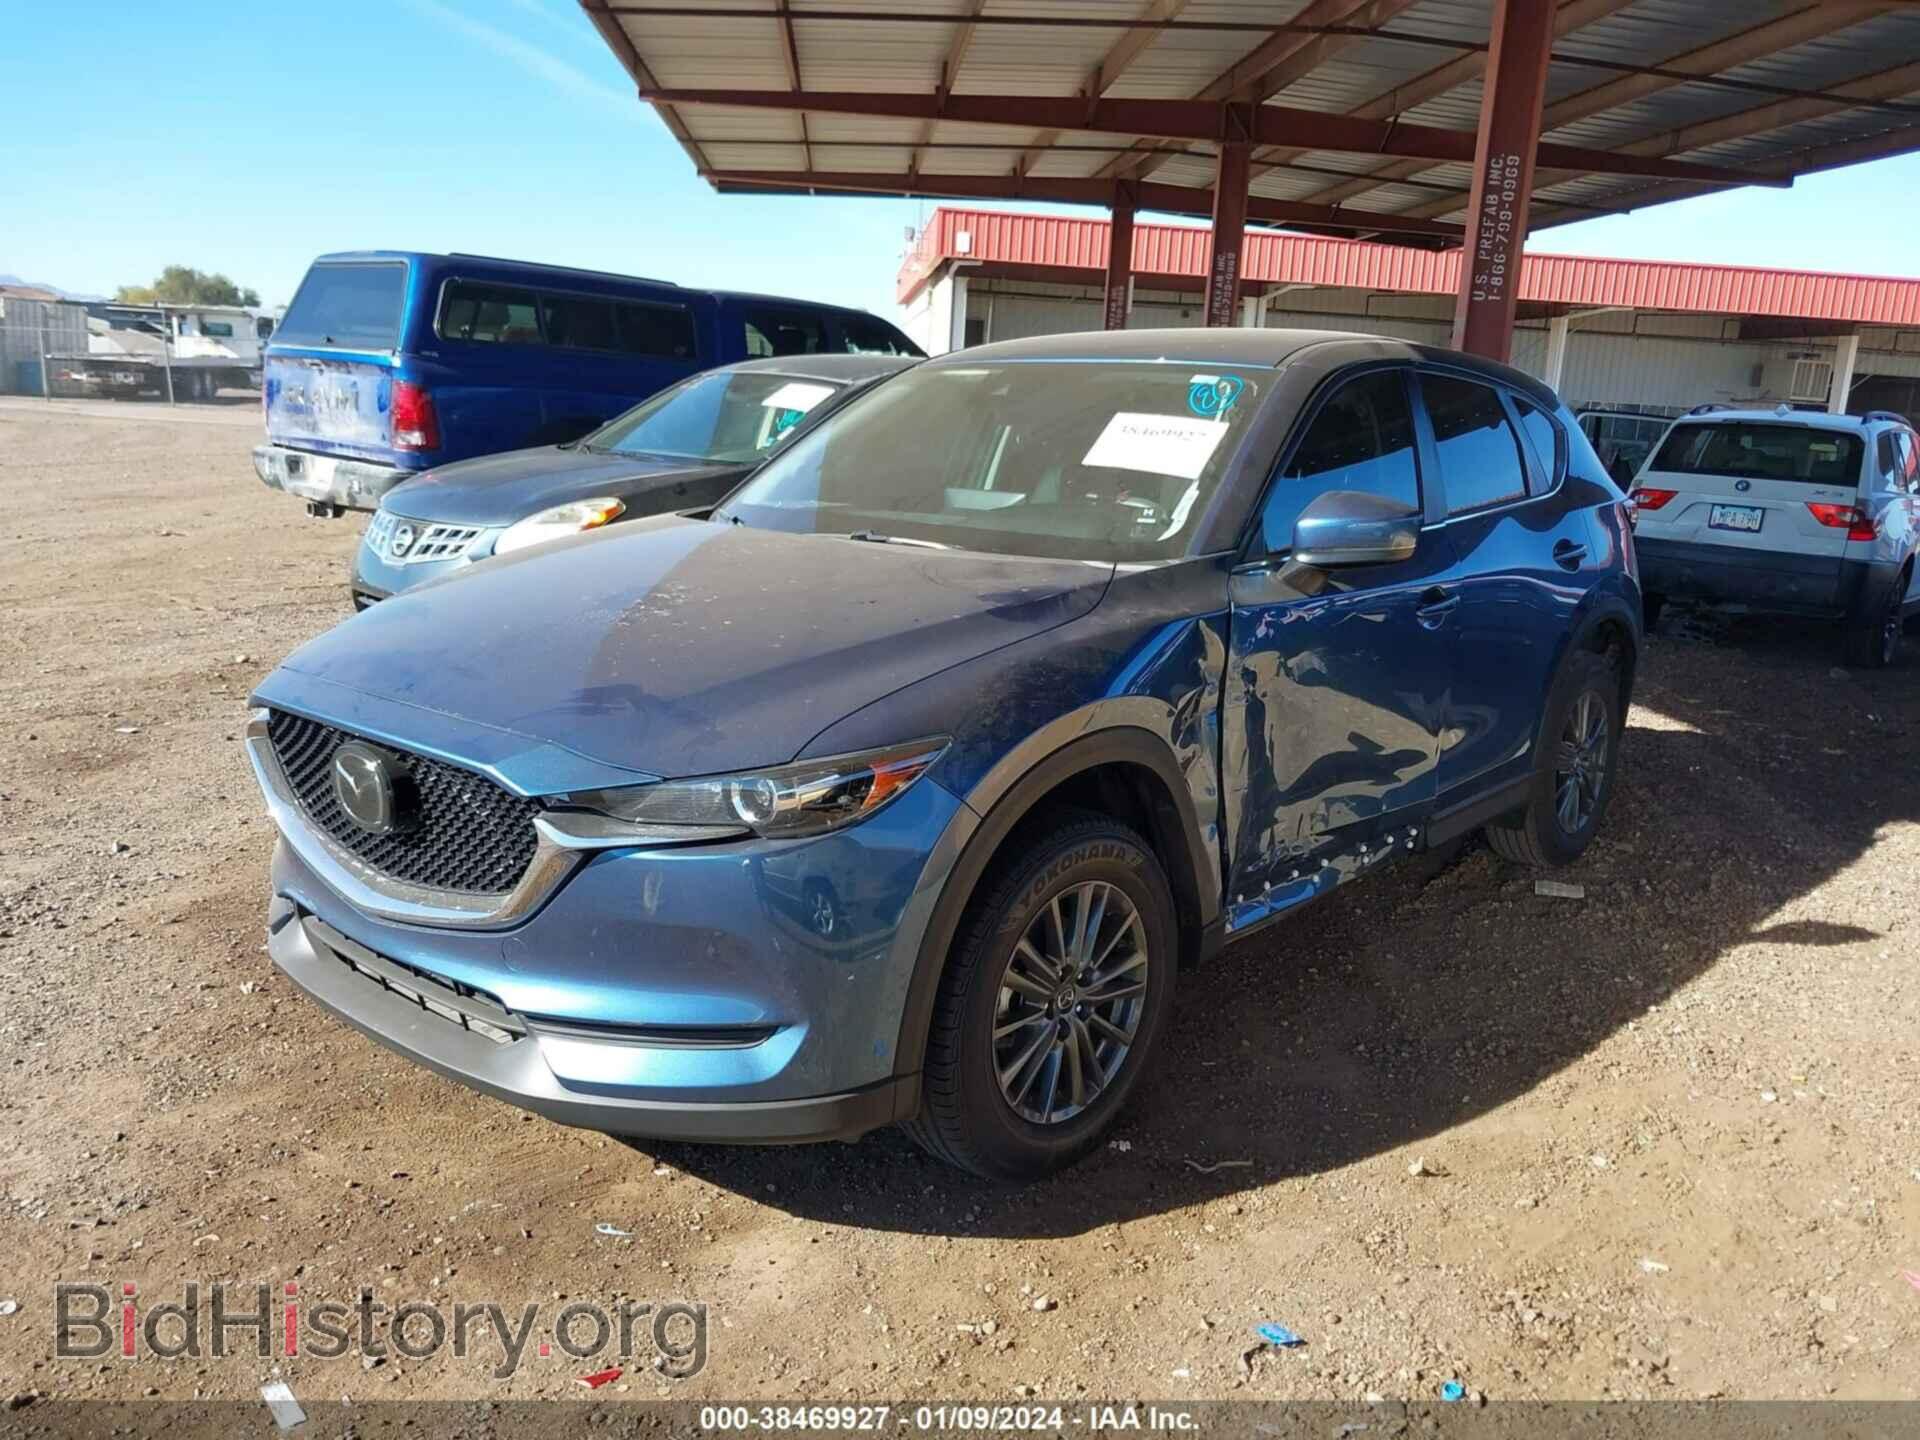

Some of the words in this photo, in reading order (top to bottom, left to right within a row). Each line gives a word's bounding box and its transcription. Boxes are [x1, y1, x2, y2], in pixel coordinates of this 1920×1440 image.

[1488, 153, 1505, 186] INC.
[1478, 194, 1500, 262] PREFAB
[1488, 155, 1521, 300] 1-866-799-0969
[1018, 842, 1126, 910] YOKOHAMA
